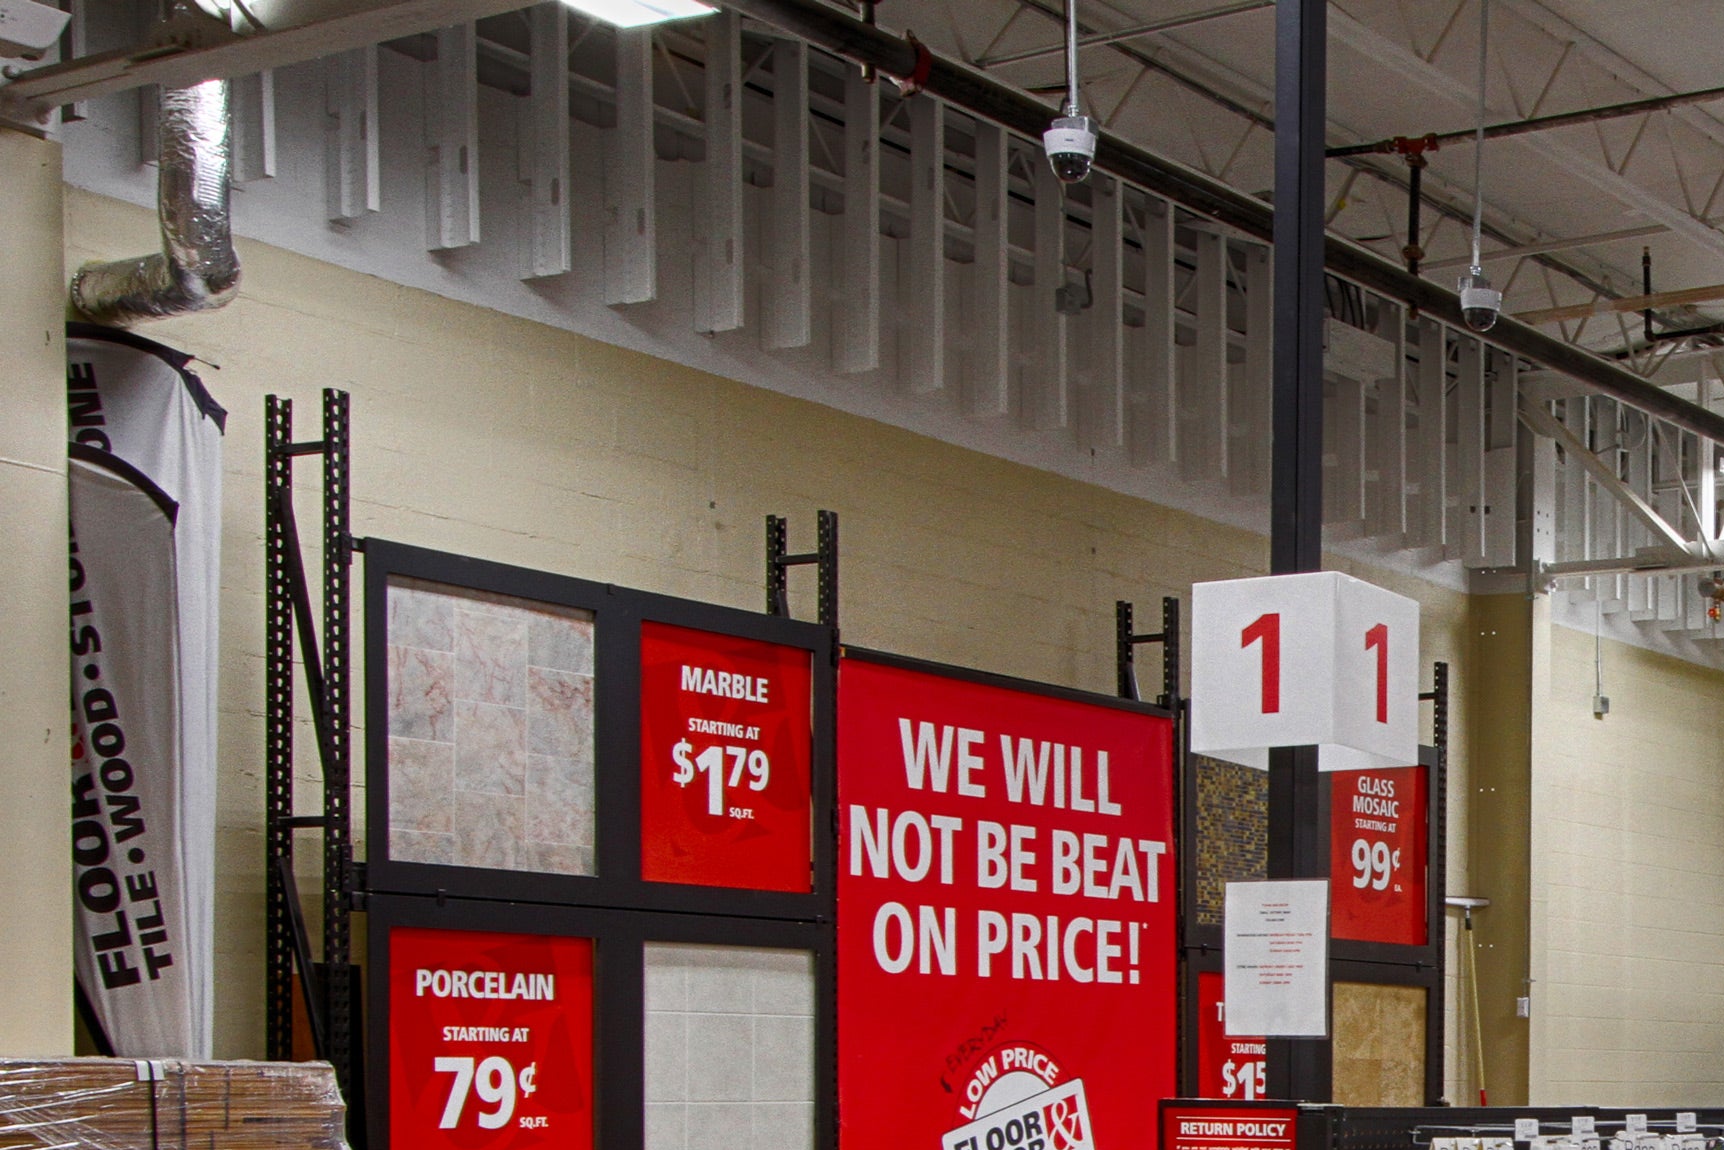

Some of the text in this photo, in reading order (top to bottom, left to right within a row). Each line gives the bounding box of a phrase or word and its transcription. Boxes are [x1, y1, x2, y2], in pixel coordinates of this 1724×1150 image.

[1240, 613, 1281, 715] 1
[1364, 622, 1389, 725] 1
[681, 664, 769, 704] MARBLE
[688, 717, 761, 741] STARTING AT
[898, 717, 1122, 816] WE WILL
[1357, 775, 1395, 798] GLASS
[729, 806, 755, 820] SQ.FT.
[1353, 794, 1400, 819] MOSAIC
[82, 686, 174, 981] TILE WOOD
[1355, 817, 1397, 833] STARTING AT
[849, 804, 1167, 904] NOT BE BEAT
[871, 900, 957, 977] ON
[415, 968, 555, 1001] PORCELAIN
[443, 1026, 530, 1042] STARTING AT
[1231, 1042, 1267, 1056] STARTING
[959, 1047, 1059, 1121] LOW PRICE
[519, 1116, 549, 1129] SQ.FT.
[1181, 1121, 1287, 1137] RETURN POLICY
